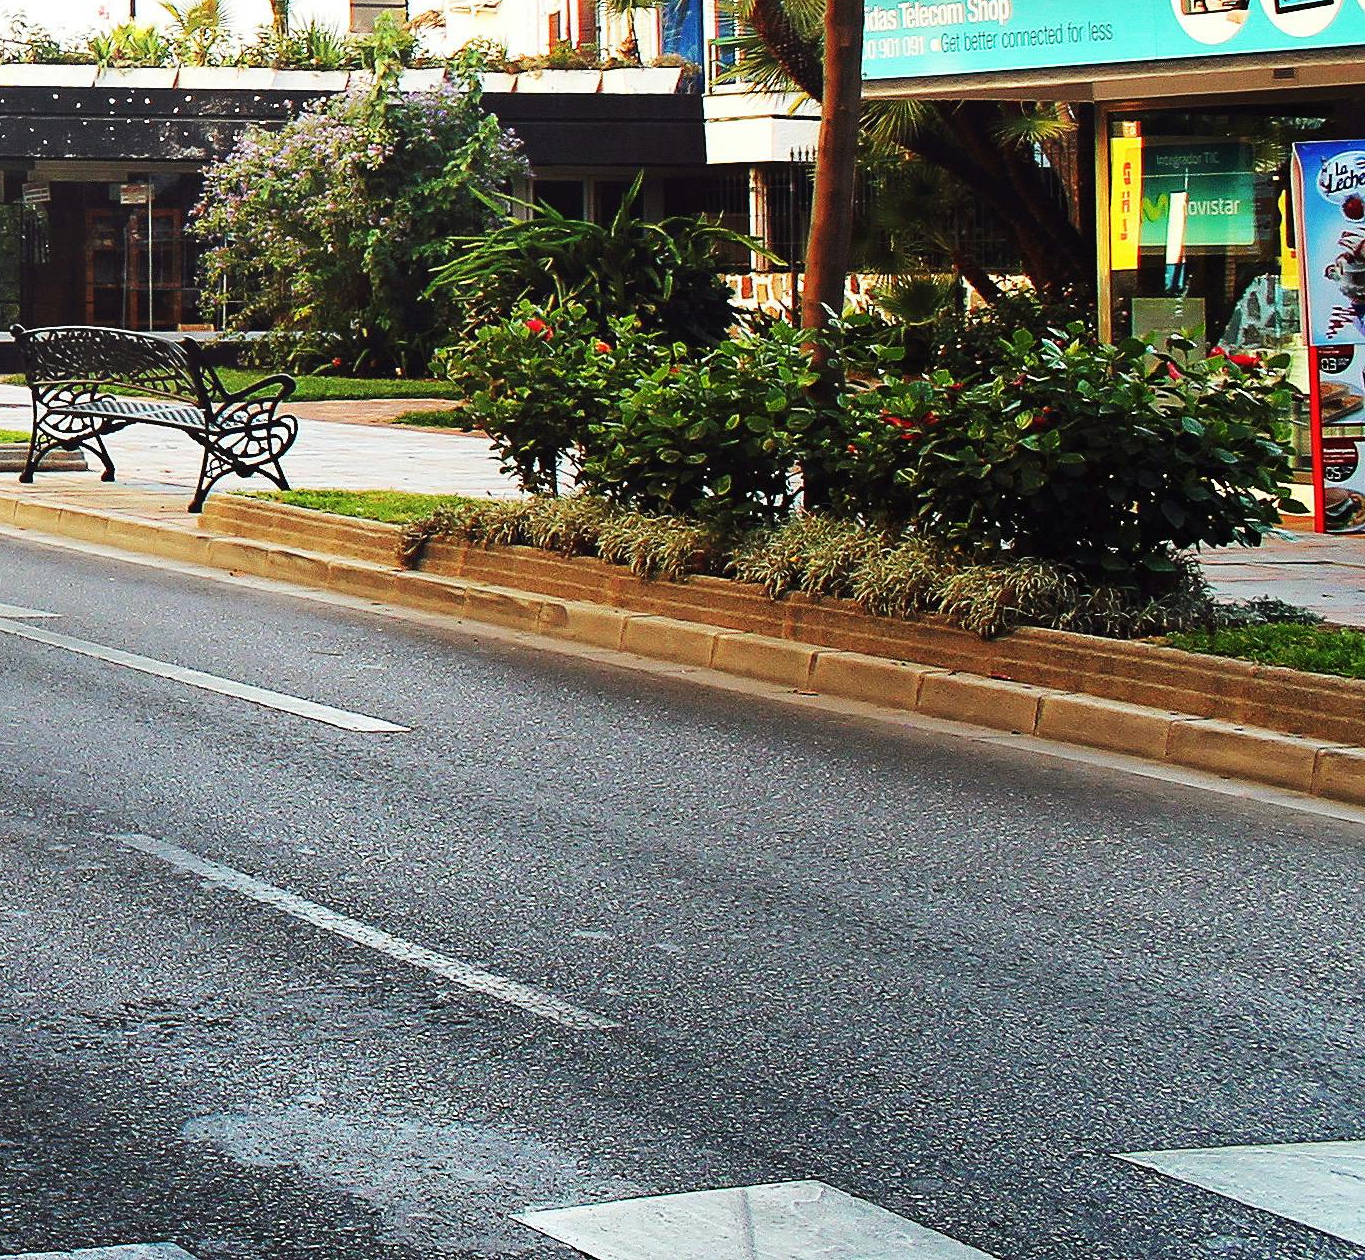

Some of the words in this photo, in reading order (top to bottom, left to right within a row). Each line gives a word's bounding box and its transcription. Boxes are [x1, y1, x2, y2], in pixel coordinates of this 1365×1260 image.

[898, 0, 965, 29] Telecom
[941, 32, 960, 53] Get
[964, 31, 997, 53] better
[1002, 24, 1063, 49] connected
[1067, 21, 1085, 43] for
[1088, 19, 1114, 42] less
[1187, 197, 1240, 215] ovistar
